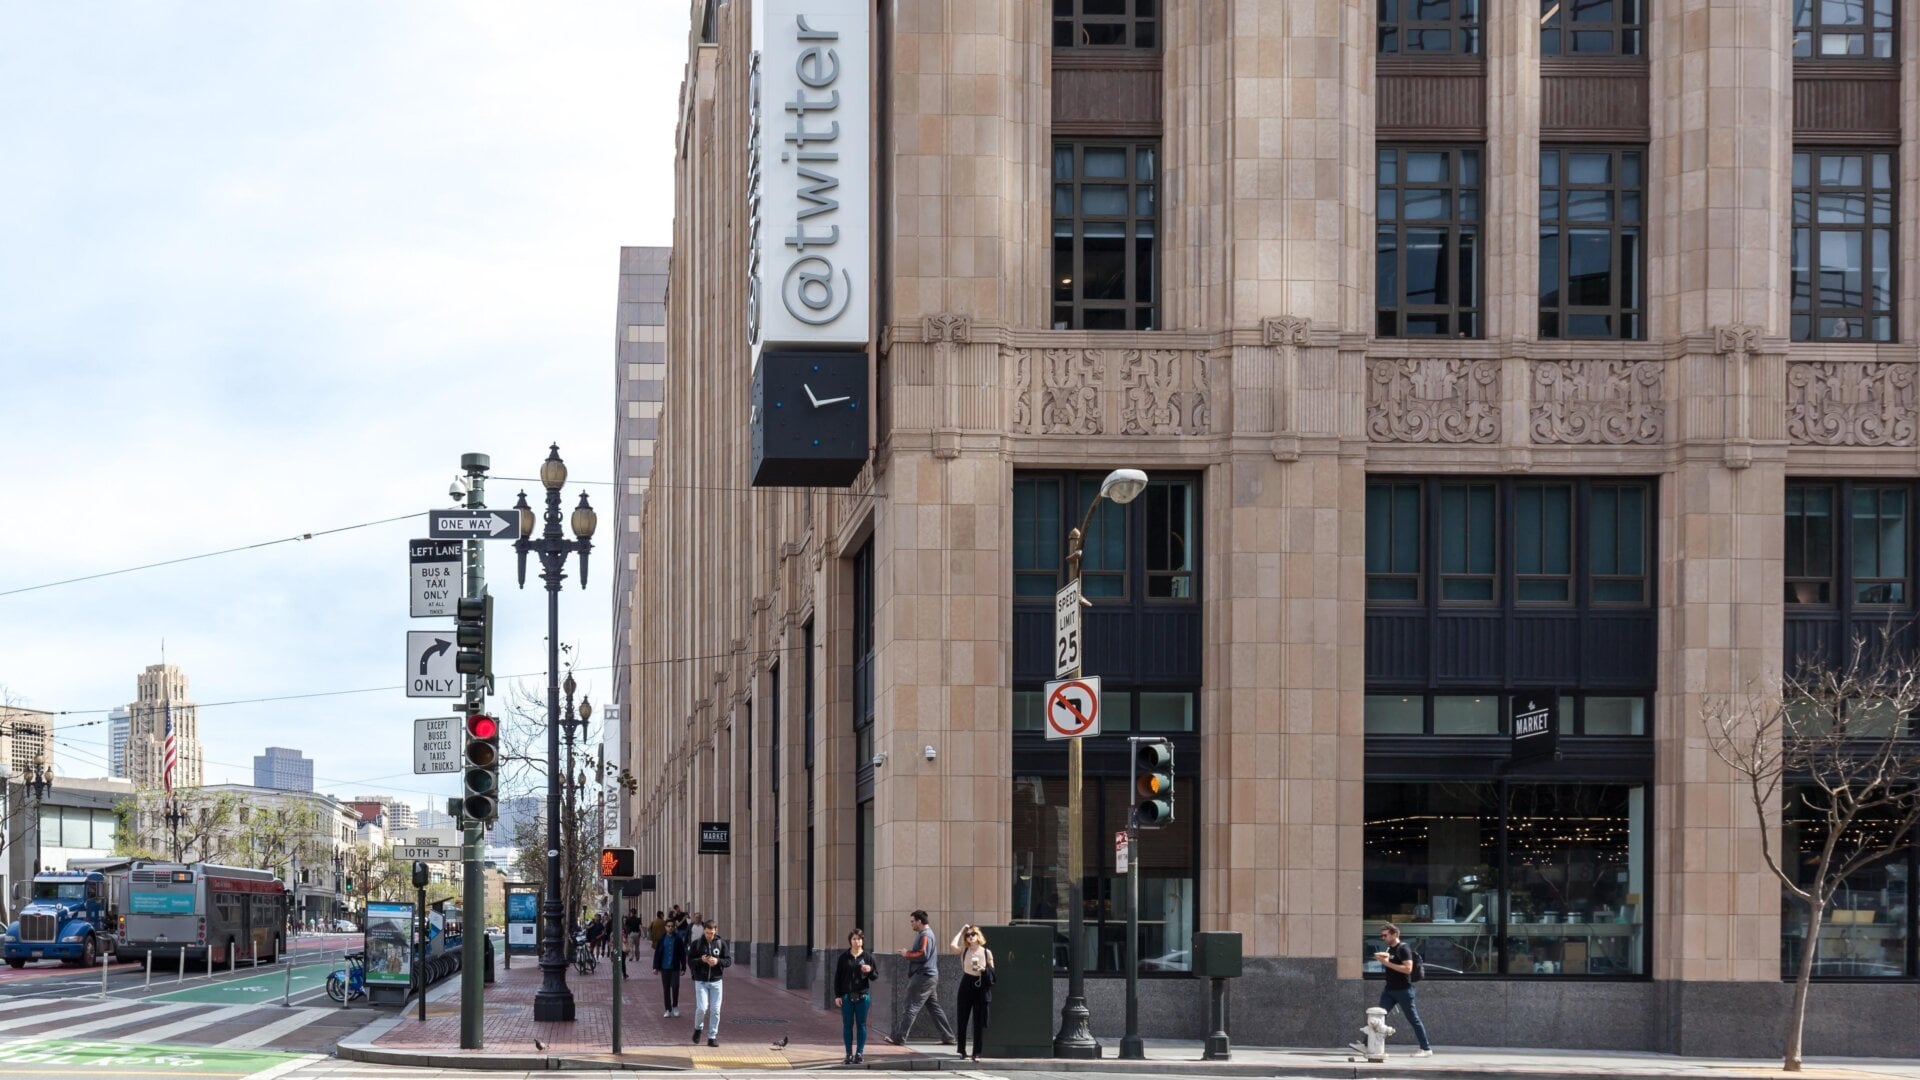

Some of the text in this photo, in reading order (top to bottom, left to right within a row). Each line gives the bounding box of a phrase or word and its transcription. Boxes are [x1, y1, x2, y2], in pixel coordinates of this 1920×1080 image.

[781, 13, 852, 326] @twitter
[441, 519, 492, 529] ONE WAY
[411, 545, 461, 557] LEFT LANE
[422, 567, 450, 577] BUS &
[426, 579, 446, 588] TAXI
[423, 590, 448, 600] ONLY
[1058, 590, 1077, 612] SPEED
[1059, 611, 1075, 631] LIMIT
[1058, 629, 1077, 669] 25
[414, 679, 454, 692] ONLY
[426, 720, 448, 730] EXCEPT
[1516, 713, 1549, 735] MARKET
[428, 731, 447, 740] BUSES
[423, 740, 452, 751] BICYCLES
[429, 752, 446, 760] TAXIS
[431, 761, 454, 771] TRUCKS
[606, 785, 618, 830] DOLBY
[703, 832, 728, 841] MARKET
[404, 848, 450, 858] 10TH ST
